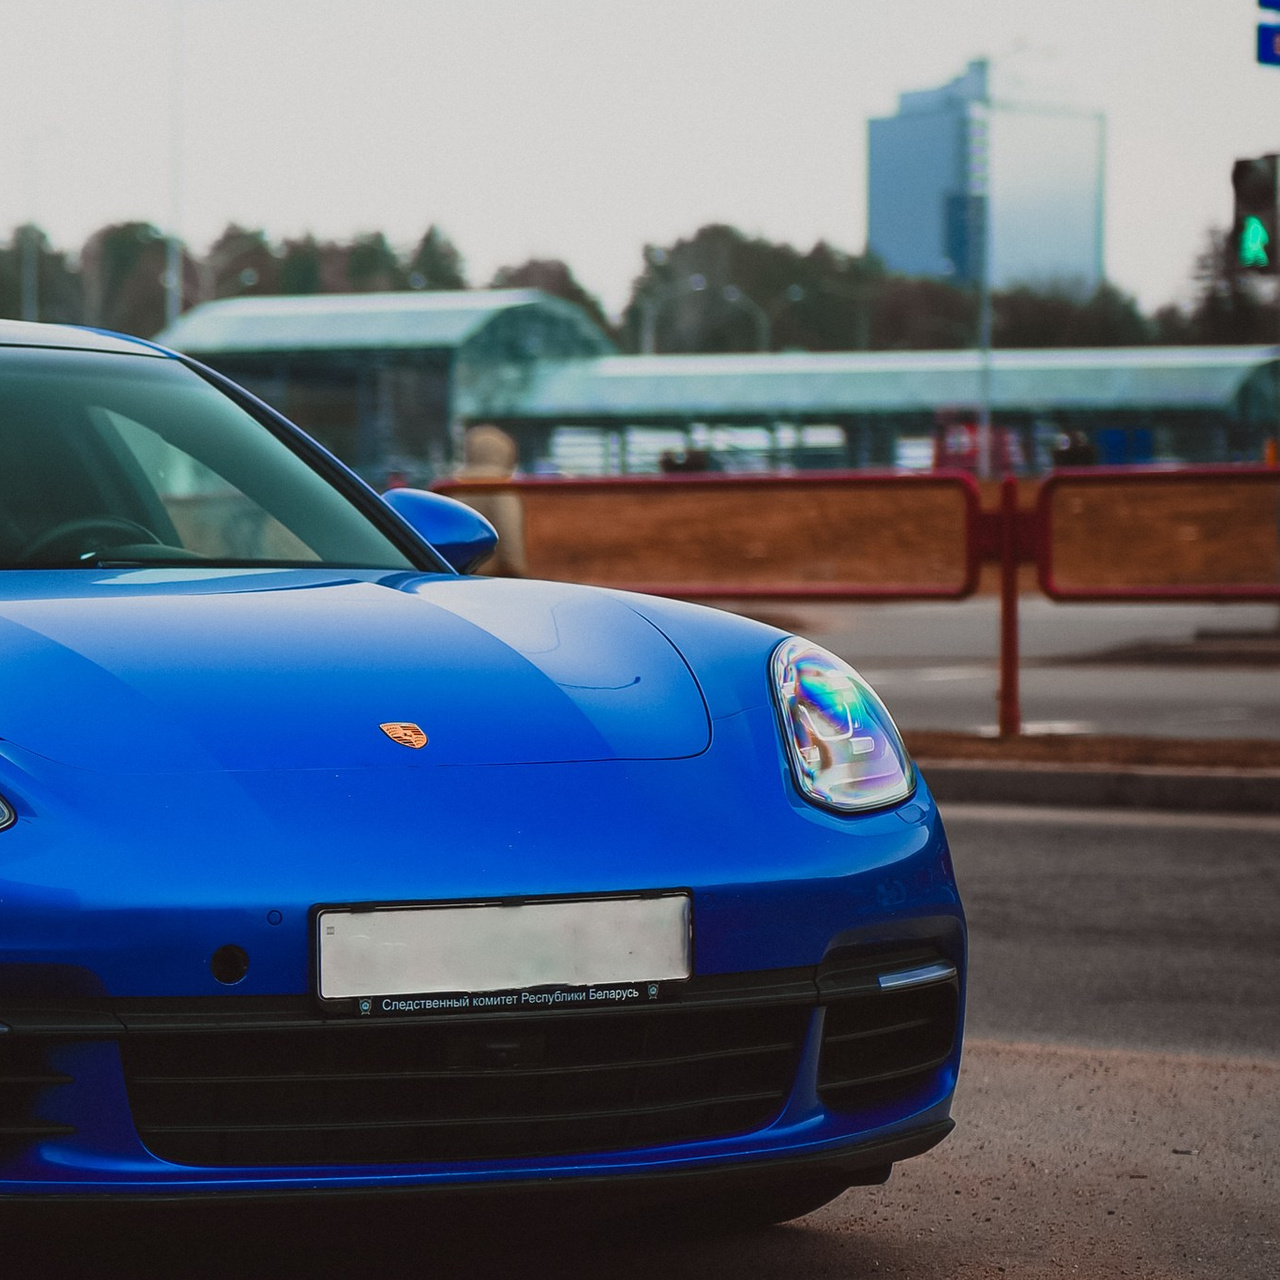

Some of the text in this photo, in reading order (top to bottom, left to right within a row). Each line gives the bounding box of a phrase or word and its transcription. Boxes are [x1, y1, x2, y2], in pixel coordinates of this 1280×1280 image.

[382, 987, 639, 1011] Следственный комитет Республики Беларусь
